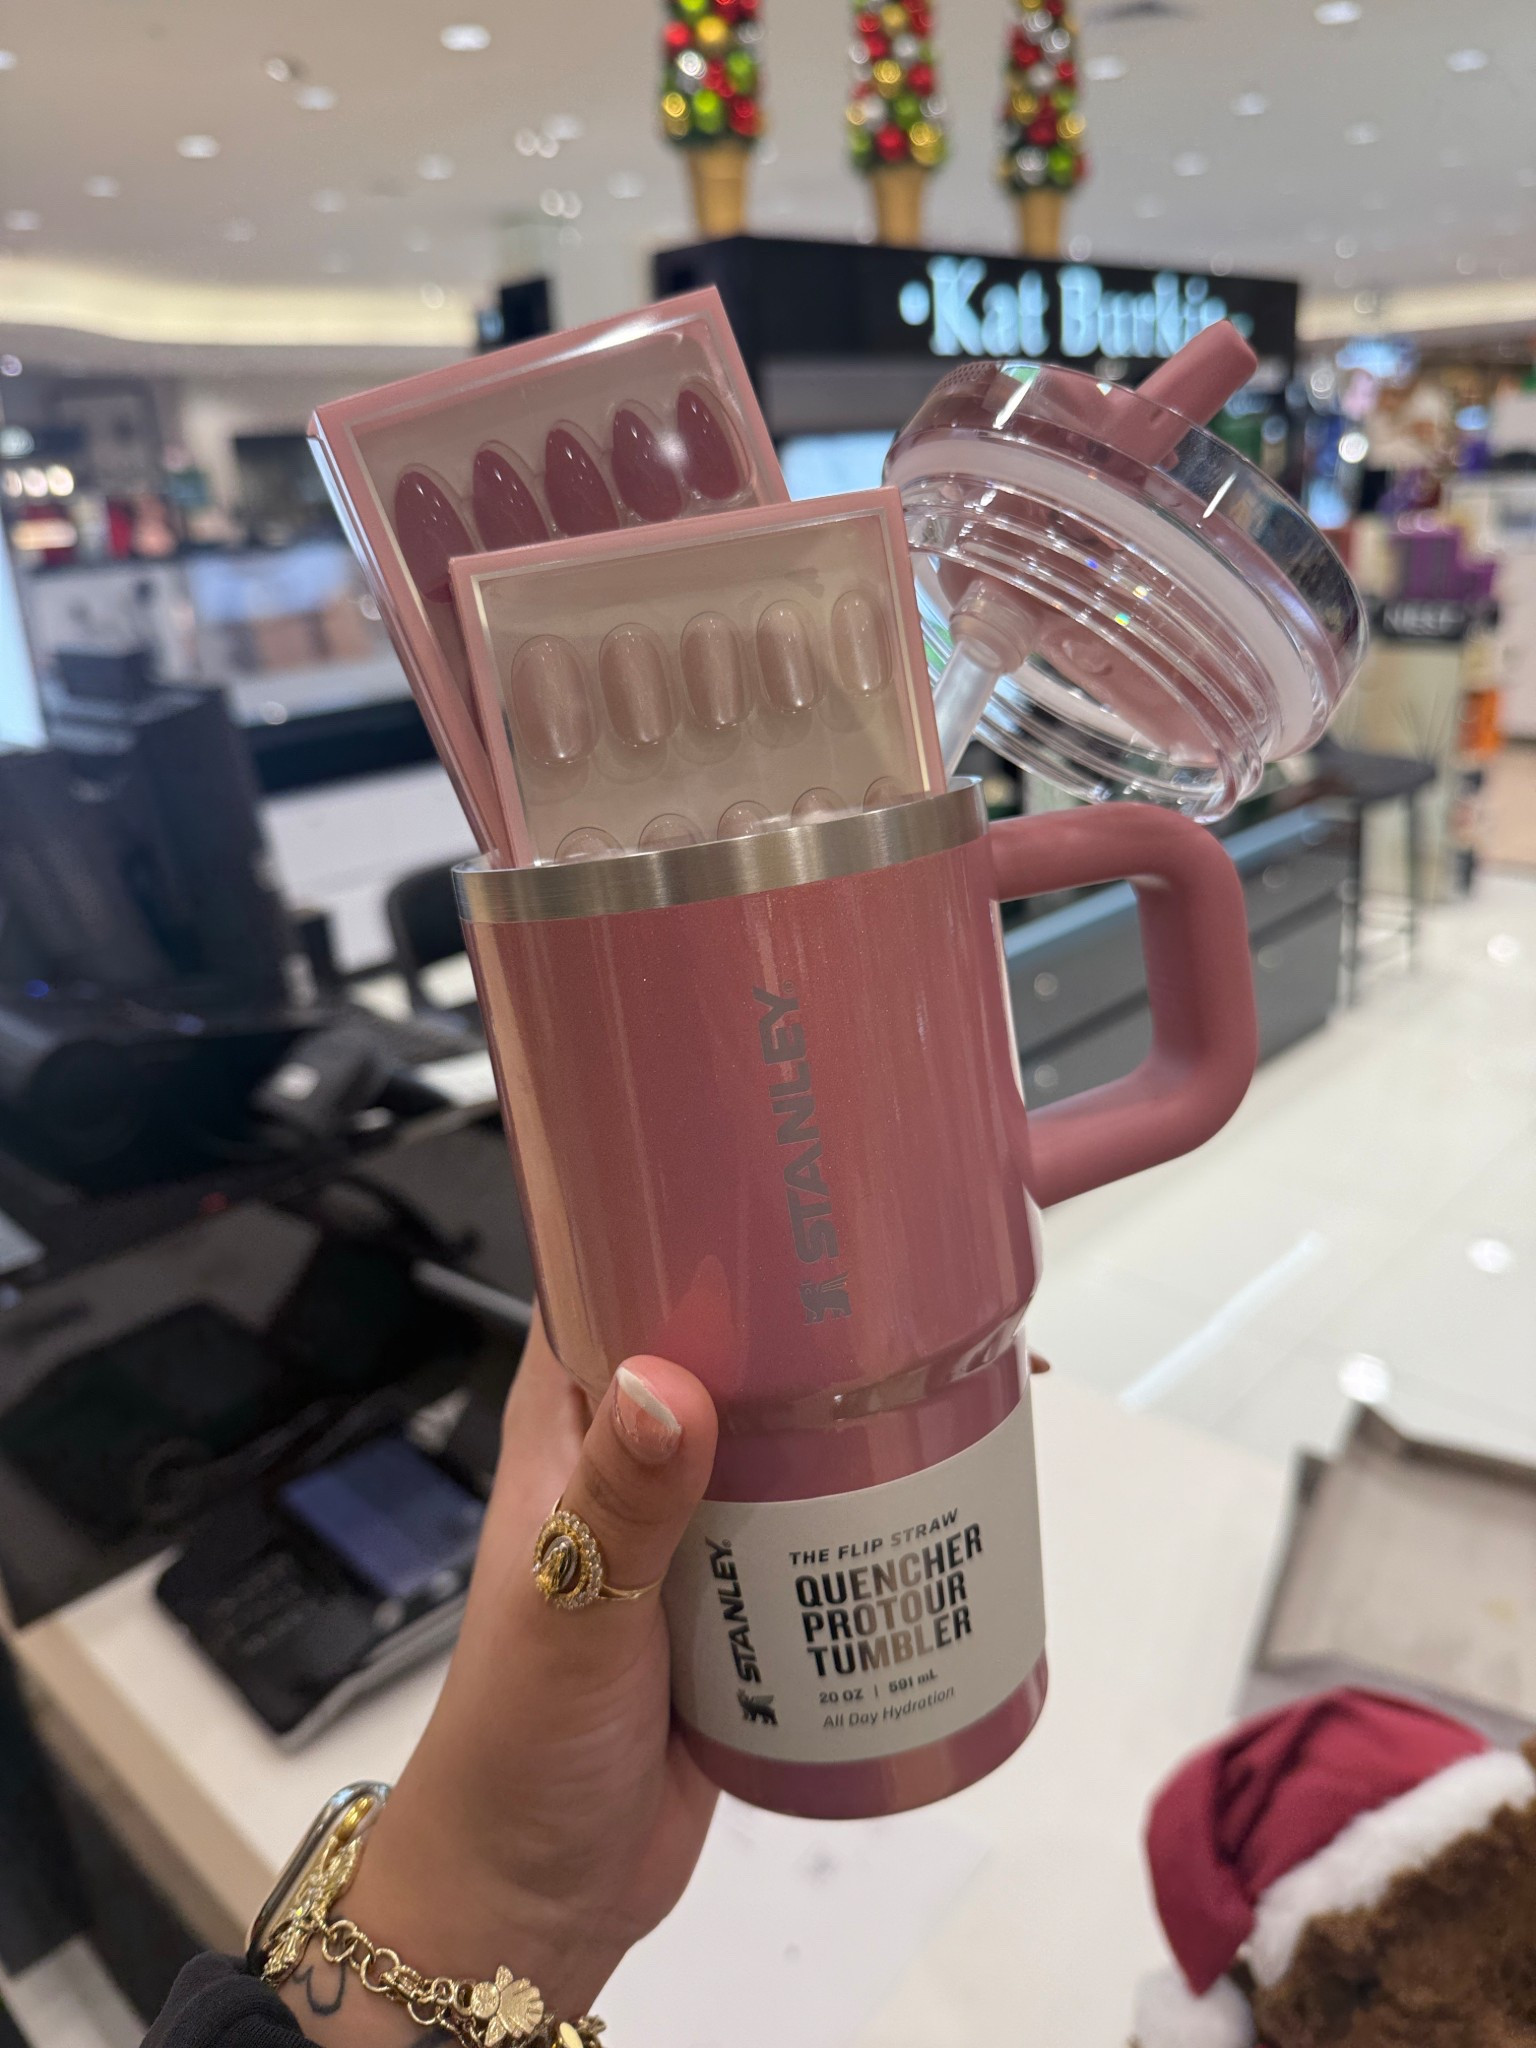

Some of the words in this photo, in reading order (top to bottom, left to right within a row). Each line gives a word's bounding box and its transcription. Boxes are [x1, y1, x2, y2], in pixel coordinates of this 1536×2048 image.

[928, 256, 1048, 356] Kat
[753, 984, 840, 1265] STANLEY
[789, 1550, 829, 1565] THE
[838, 1537, 884, 1560] FLIP
[891, 1508, 958, 1547] STRAW
[795, 1523, 983, 1608] QUENCHER
[705, 1535, 761, 1684] STANLEY
[802, 1570, 967, 1643] PROTOUR
[806, 1605, 972, 1677] TUMBLER
[819, 1691, 839, 1704] 20
[889, 1675, 914, 1694] 591
[917, 1668, 938, 1684] mL
[823, 1714, 844, 1728] All
[849, 1711, 878, 1727] Day
[883, 1686, 955, 1721] Hydration
